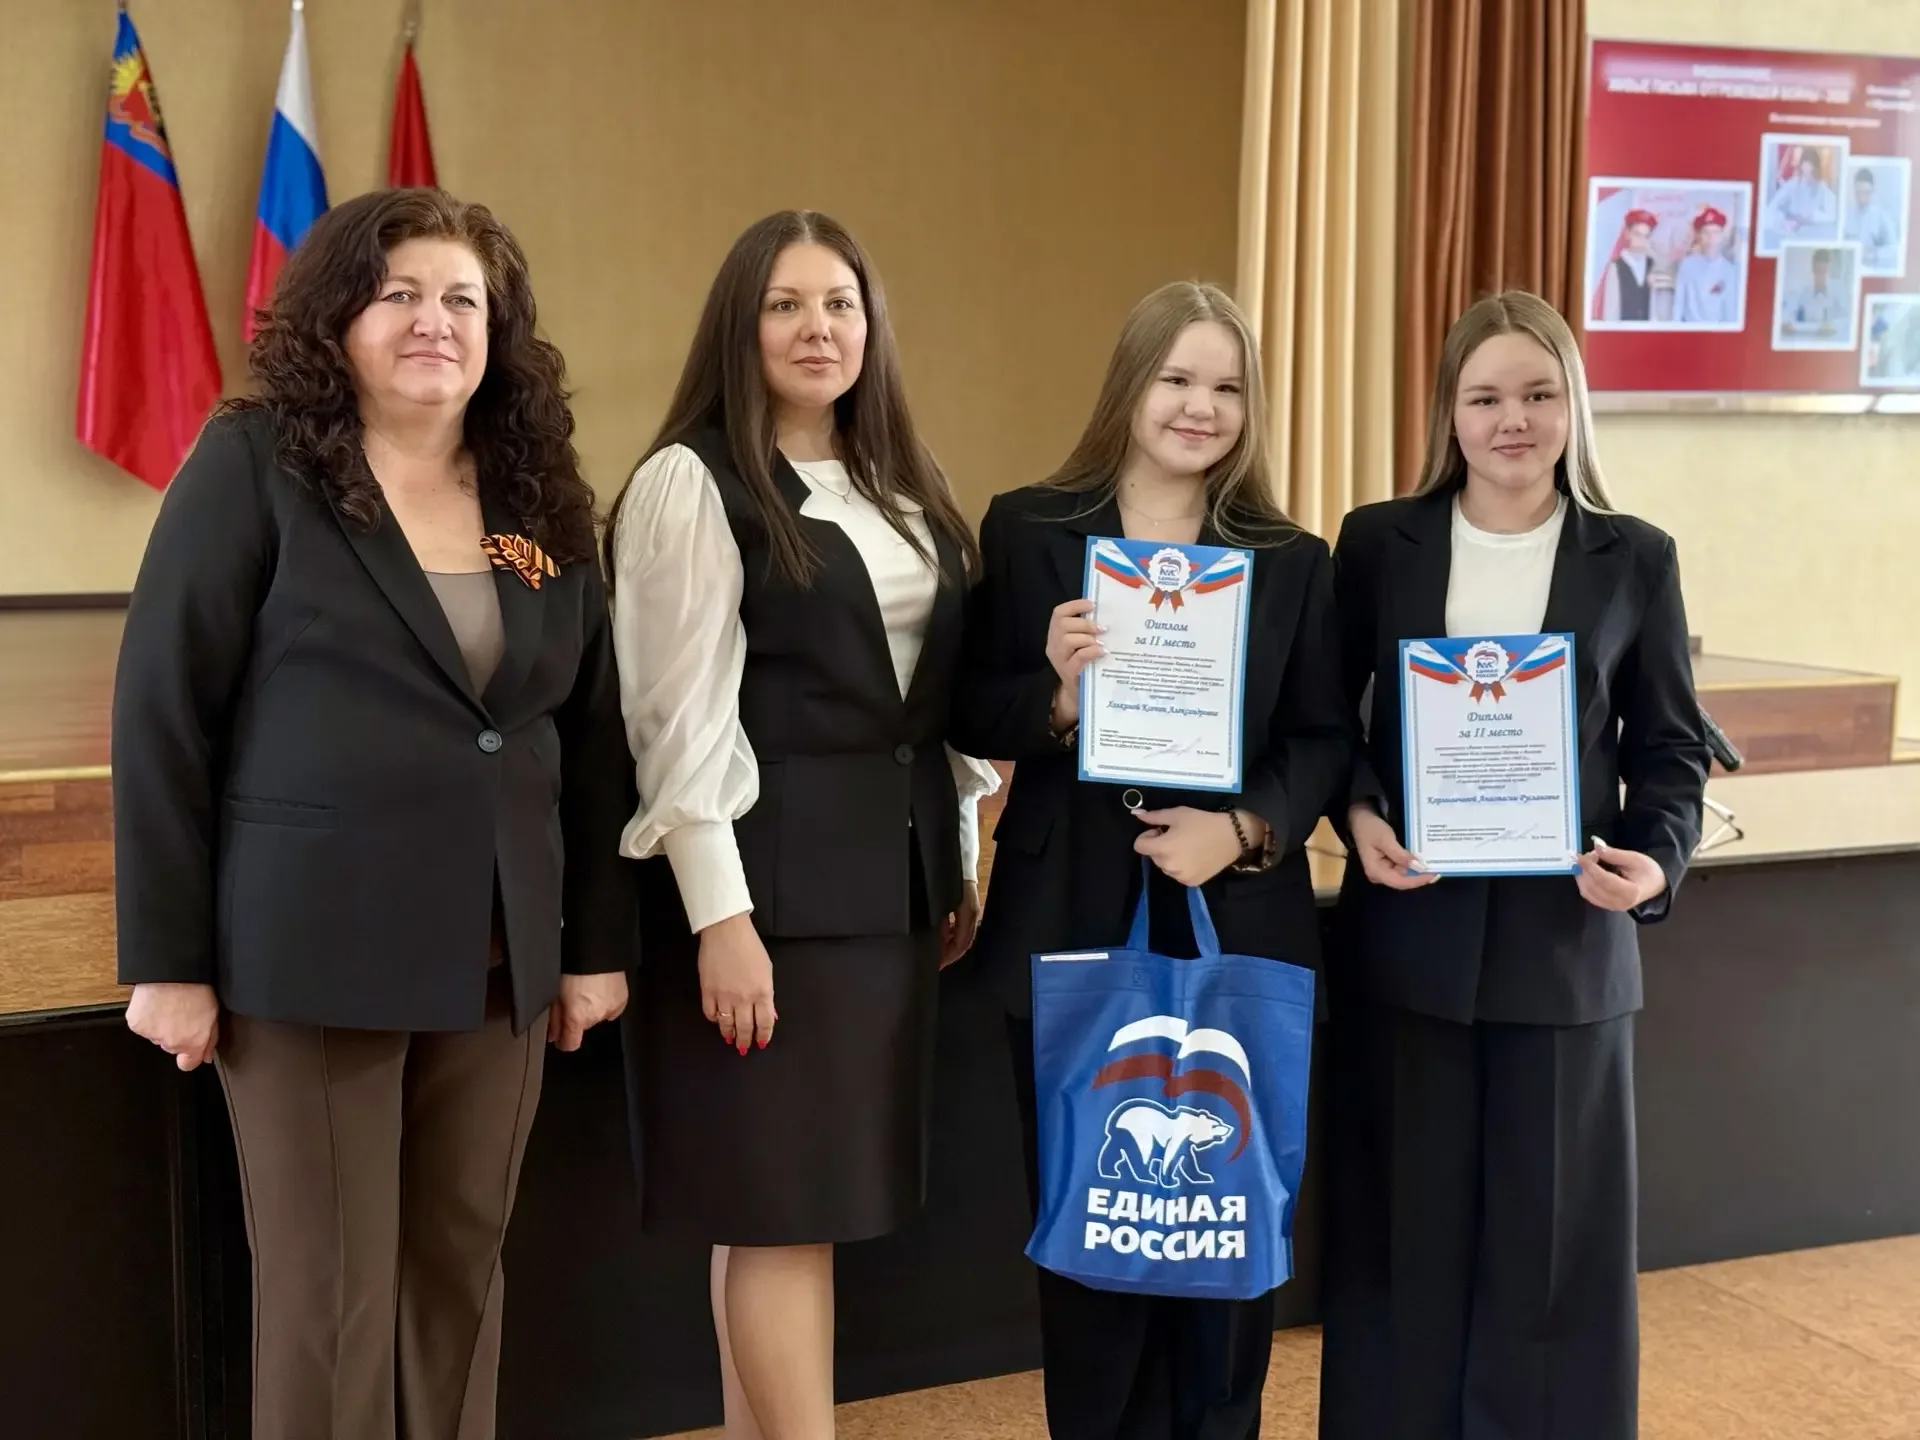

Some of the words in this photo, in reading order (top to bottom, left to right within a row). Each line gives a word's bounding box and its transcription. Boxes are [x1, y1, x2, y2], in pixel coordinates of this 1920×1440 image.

[1144, 618, 1189, 632] Диплом
[1134, 635, 1147, 645] за
[1149, 635, 1161, 646] II
[1163, 638, 1196, 649] место
[1466, 711, 1513, 722] Диплом
[1458, 730, 1471, 738] за
[1474, 727, 1487, 738] II
[1488, 729, 1523, 738] место
[1087, 1187, 1247, 1225] ЕДИНАЯ
[1084, 1221, 1246, 1261] РОССИЯ
